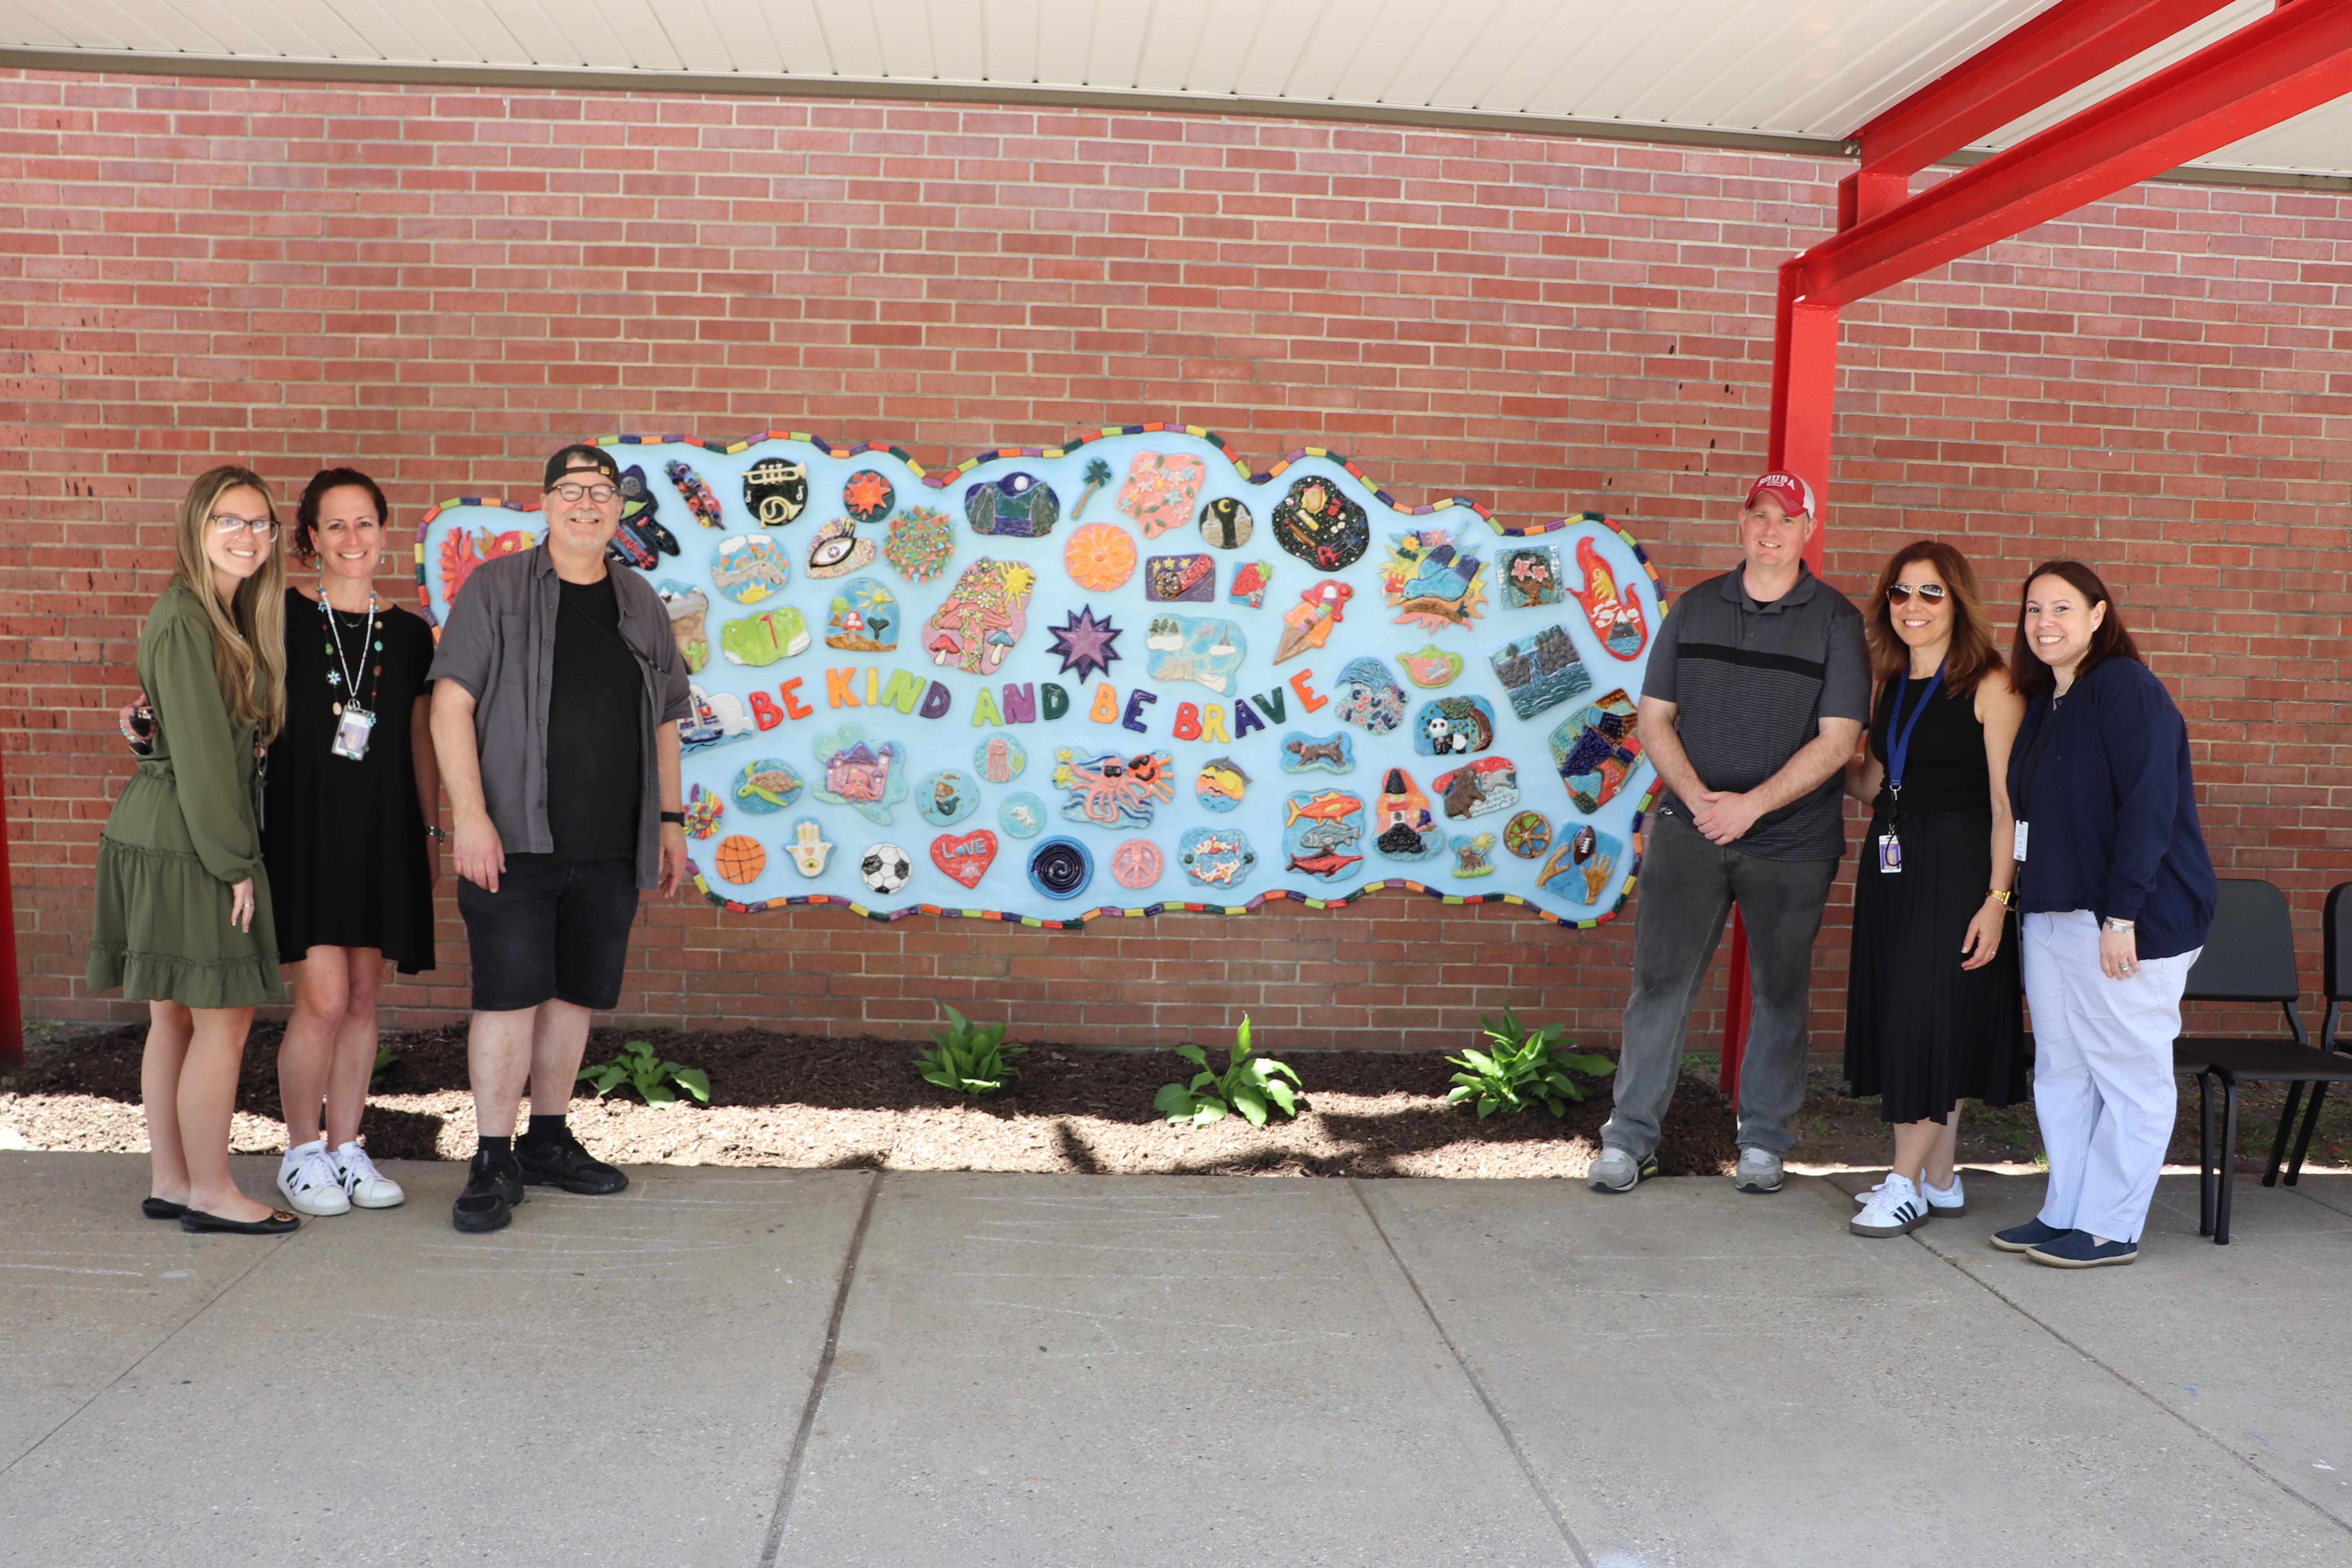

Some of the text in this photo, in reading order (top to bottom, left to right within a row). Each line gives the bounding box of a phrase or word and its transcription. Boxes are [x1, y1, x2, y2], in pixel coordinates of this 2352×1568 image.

[749, 667, 1328, 743] BE KIND AND BE BRAVE
